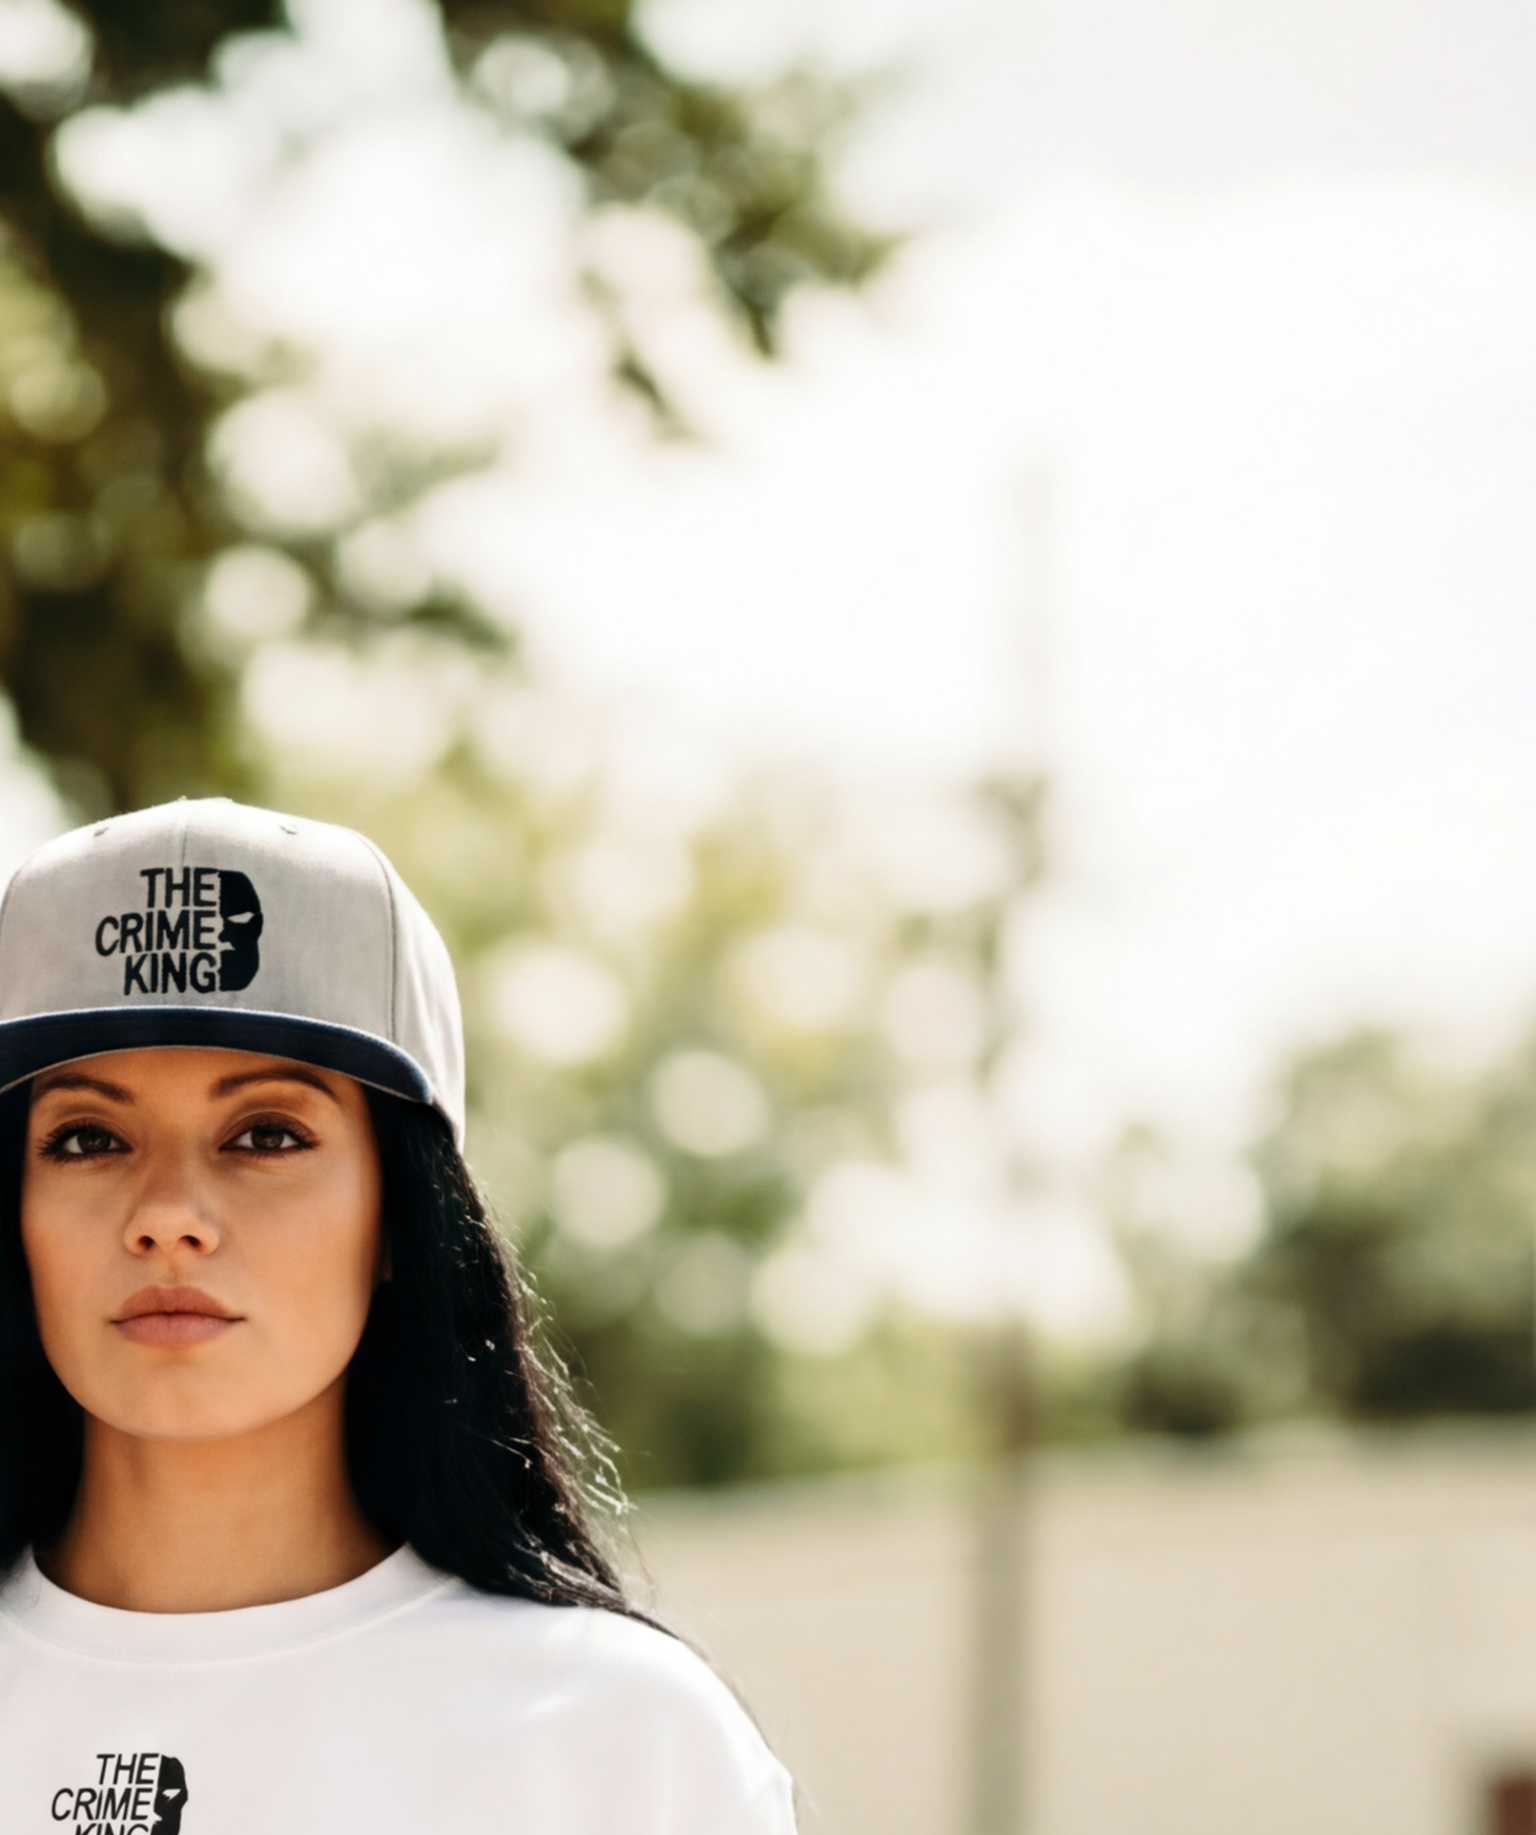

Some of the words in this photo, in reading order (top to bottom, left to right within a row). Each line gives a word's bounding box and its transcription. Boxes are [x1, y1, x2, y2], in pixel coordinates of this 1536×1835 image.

[140, 867, 220, 908] THE
[95, 910, 217, 957] CRIME
[124, 951, 218, 996] KING
[96, 1752, 160, 1785] THE
[51, 1787, 154, 1821] CRIME
